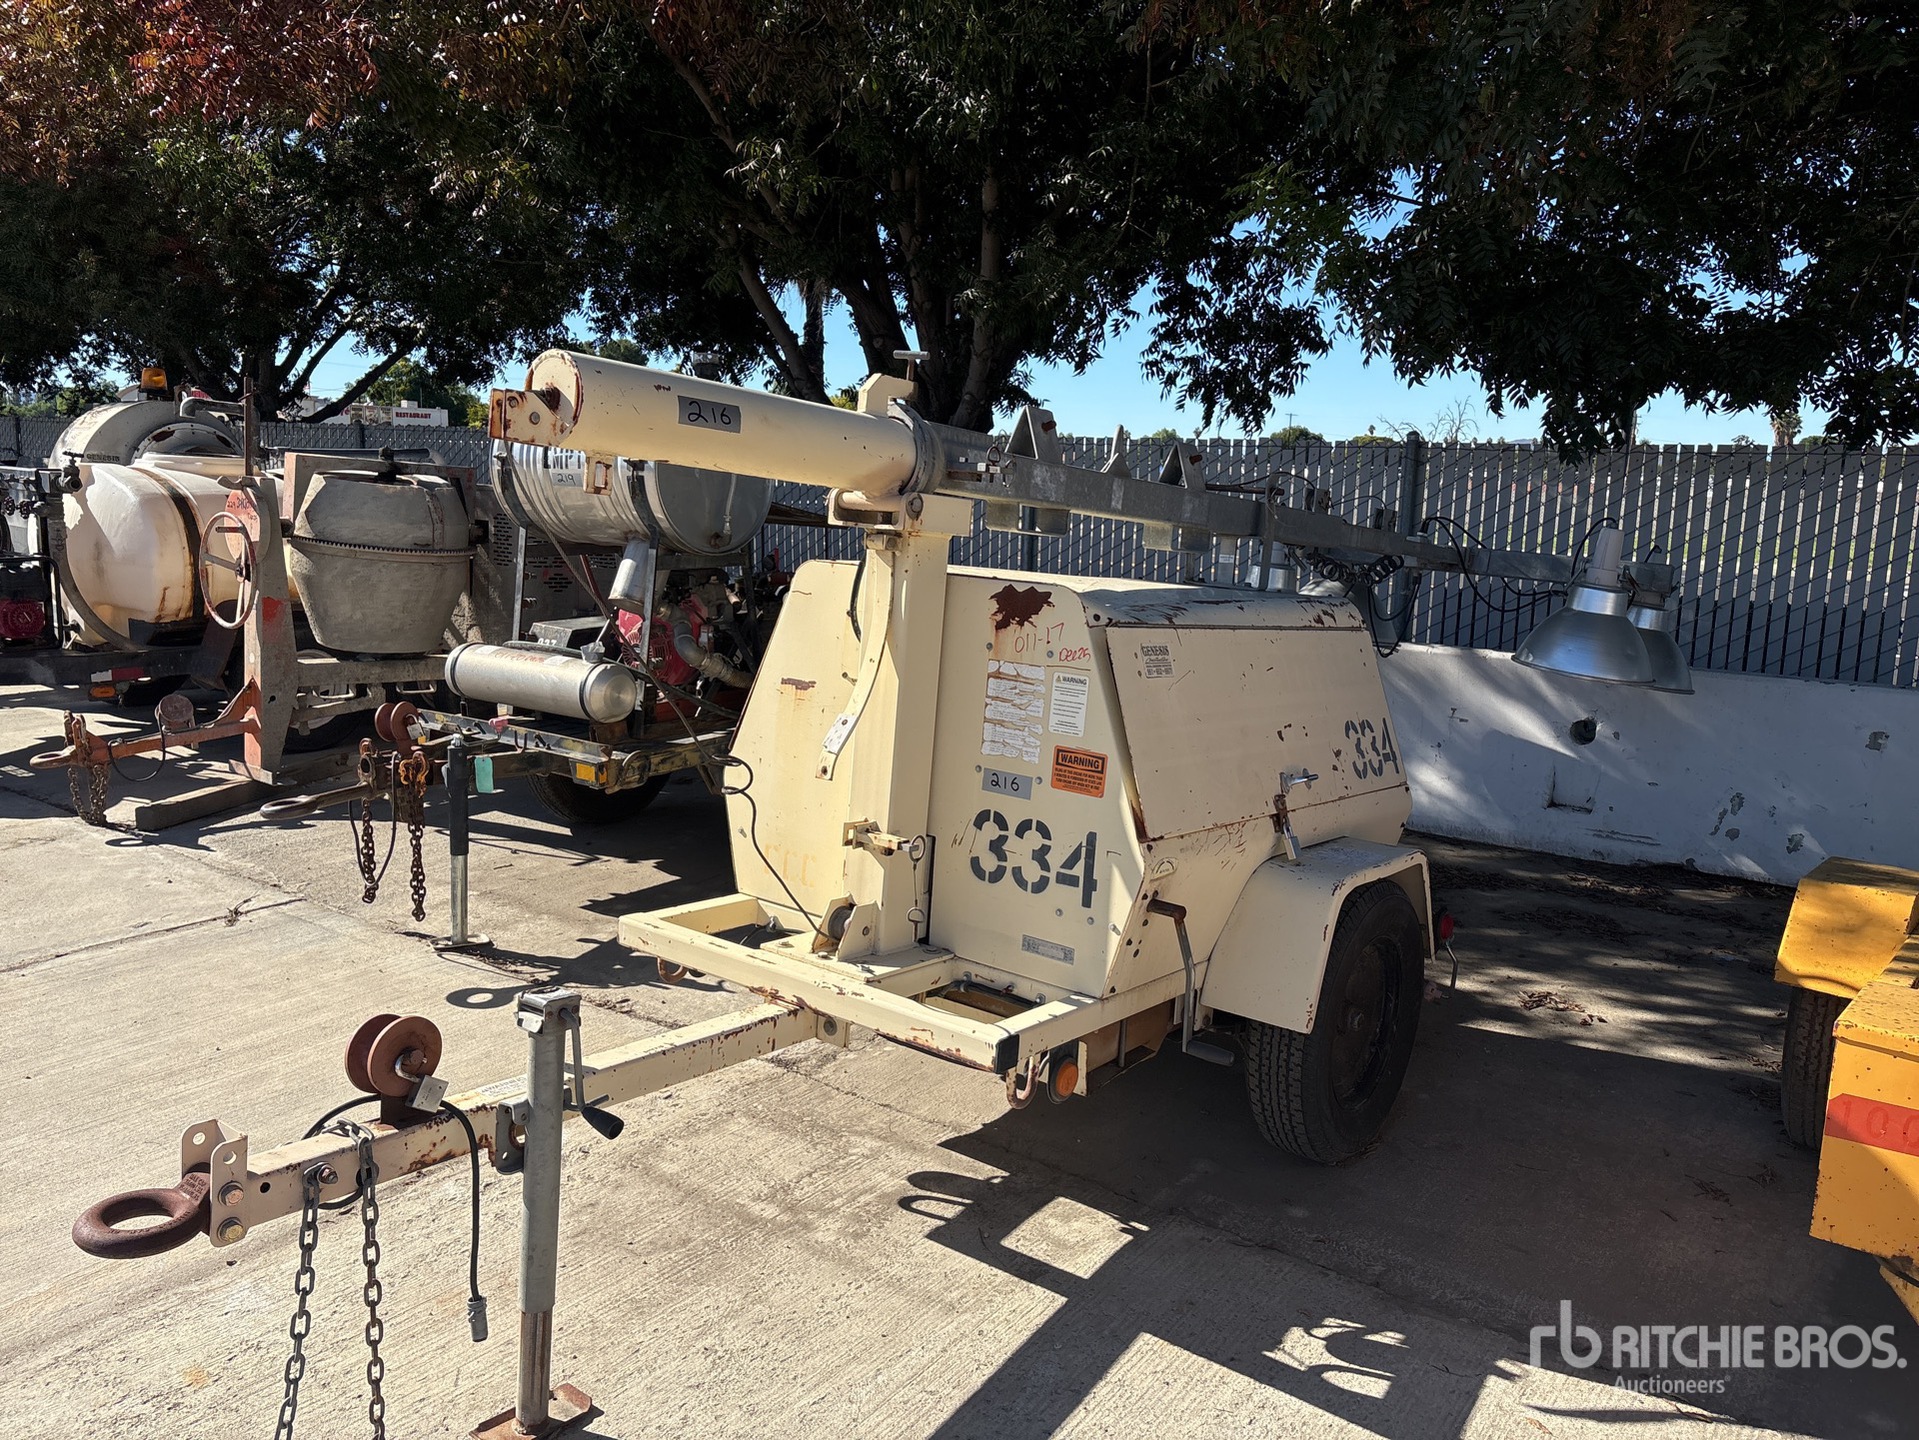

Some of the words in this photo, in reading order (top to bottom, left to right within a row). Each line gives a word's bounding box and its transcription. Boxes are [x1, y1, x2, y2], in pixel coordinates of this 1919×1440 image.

[395, 411, 432, 419] RESTAURANT
[687, 400, 732, 425] 216
[557, 473, 576, 486] 219
[1141, 645, 1170, 656] GENESIS
[1062, 676, 1088, 685] WARNING
[1344, 717, 1400, 779] 334
[1060, 753, 1100, 769] WARNING
[990, 772, 1020, 791] 216
[970, 808, 1098, 909] 334
